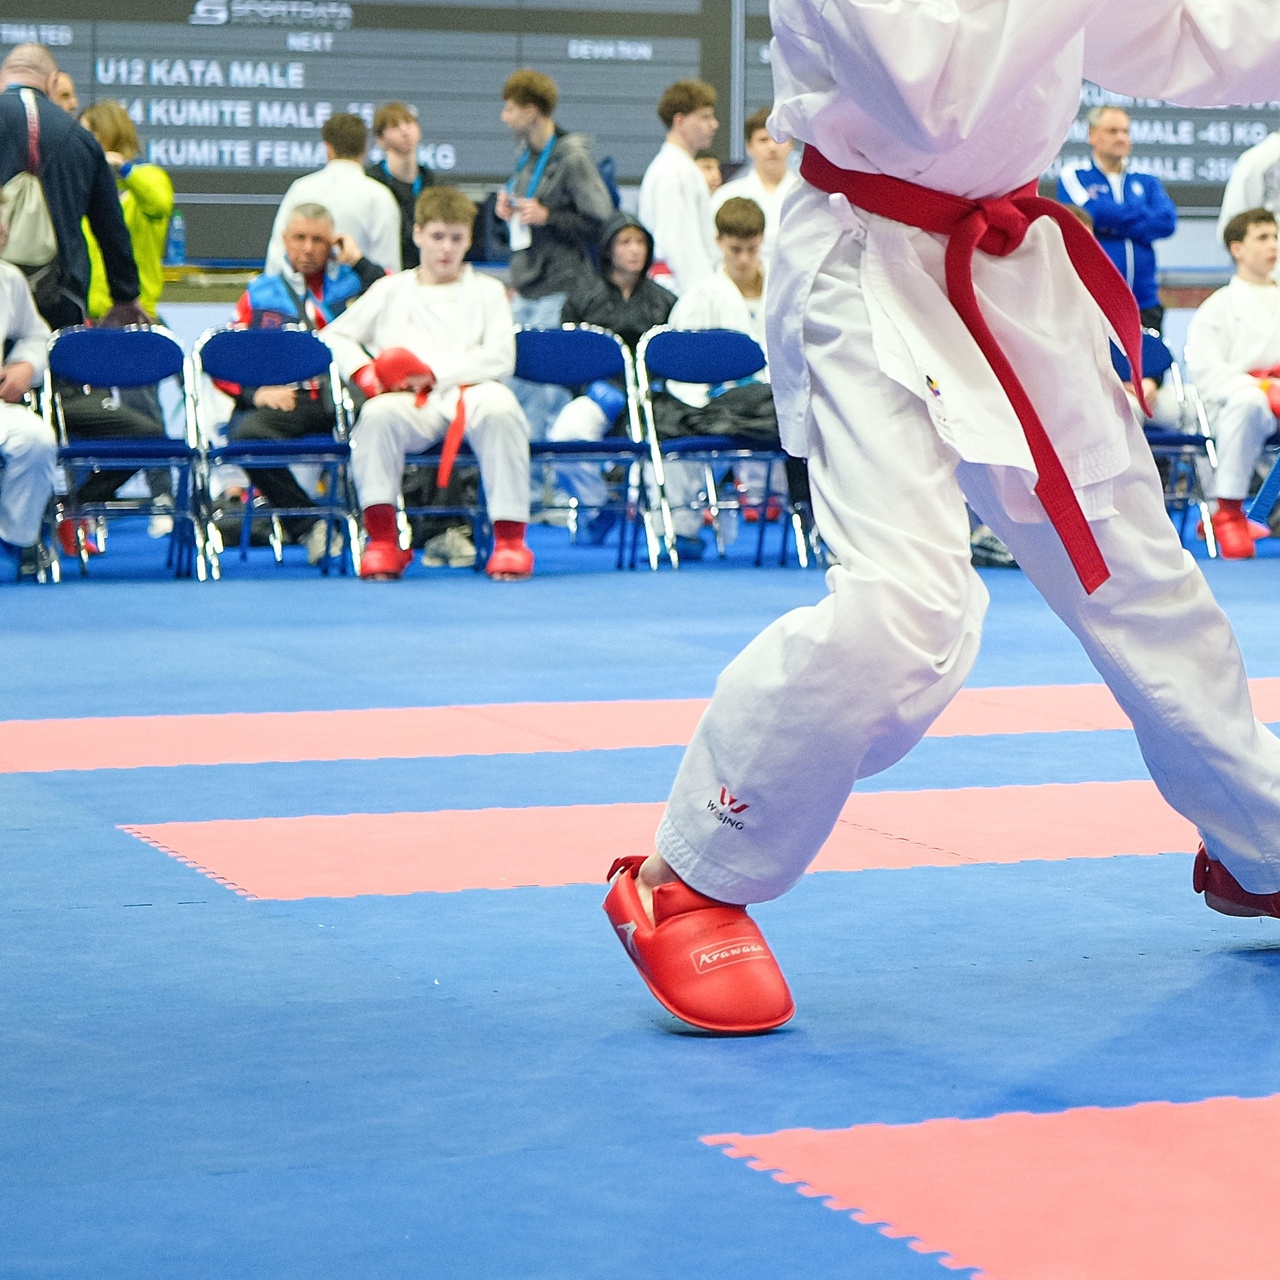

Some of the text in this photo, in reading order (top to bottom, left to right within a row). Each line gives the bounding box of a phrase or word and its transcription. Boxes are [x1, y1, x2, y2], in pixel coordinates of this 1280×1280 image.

[286, 32, 334, 52] NEXT
[95, 57, 305, 89] U12 KATA MALE
[148, 98, 252, 127] KUMITE
[147, 138, 251, 167] KUMITE
[256, 140, 326, 168] FEMA
